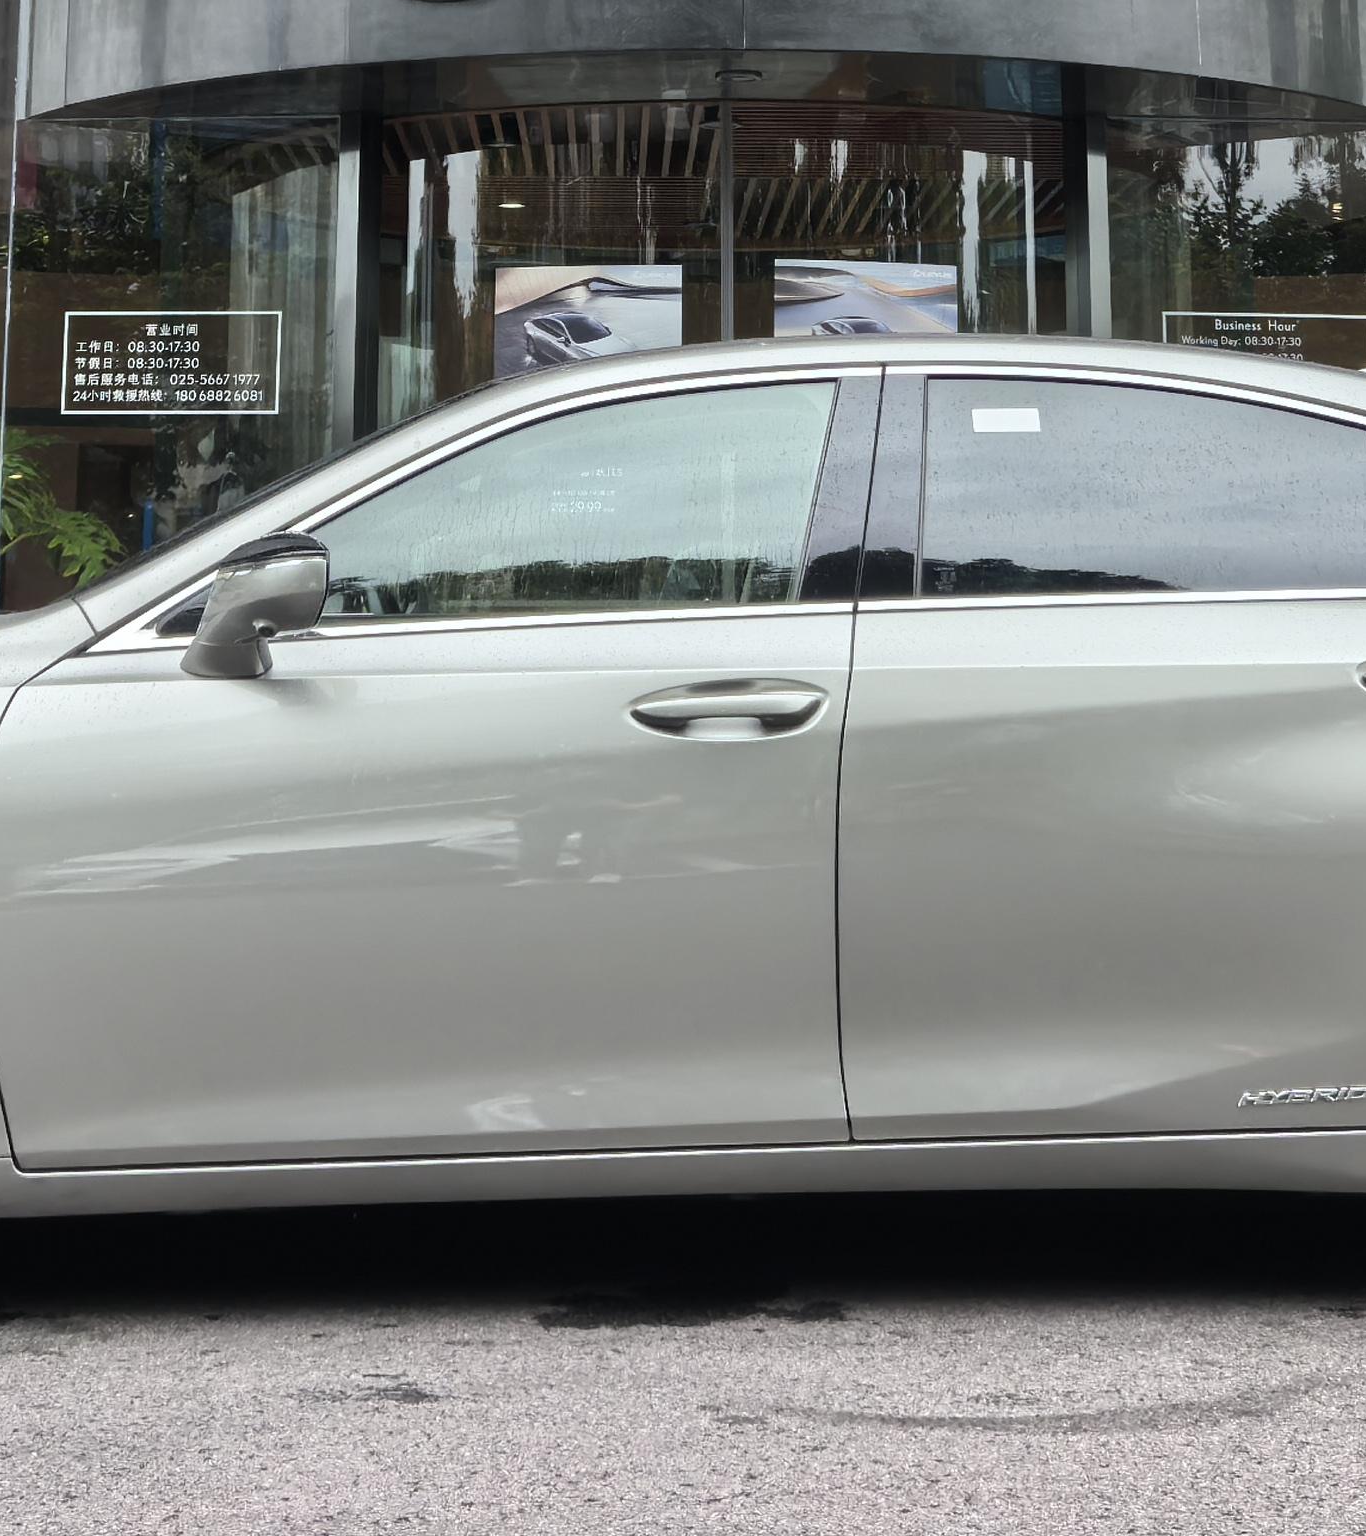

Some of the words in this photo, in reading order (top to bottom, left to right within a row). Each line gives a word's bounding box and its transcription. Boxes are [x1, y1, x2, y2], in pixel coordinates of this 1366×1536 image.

[145, 323, 199, 337] 营业时间
[1214, 319, 1262, 332] Business
[75, 340, 120, 354] 工作日：
[1181, 335, 1218, 347] Working
[1220, 336, 1241, 347] Day:
[1244, 336, 1302, 347] 08:30-17:30
[75, 356, 120, 370] 节假日：
[127, 357, 200, 369] 08:30-17:30
[74, 373, 159, 387] 售后服务电话：
